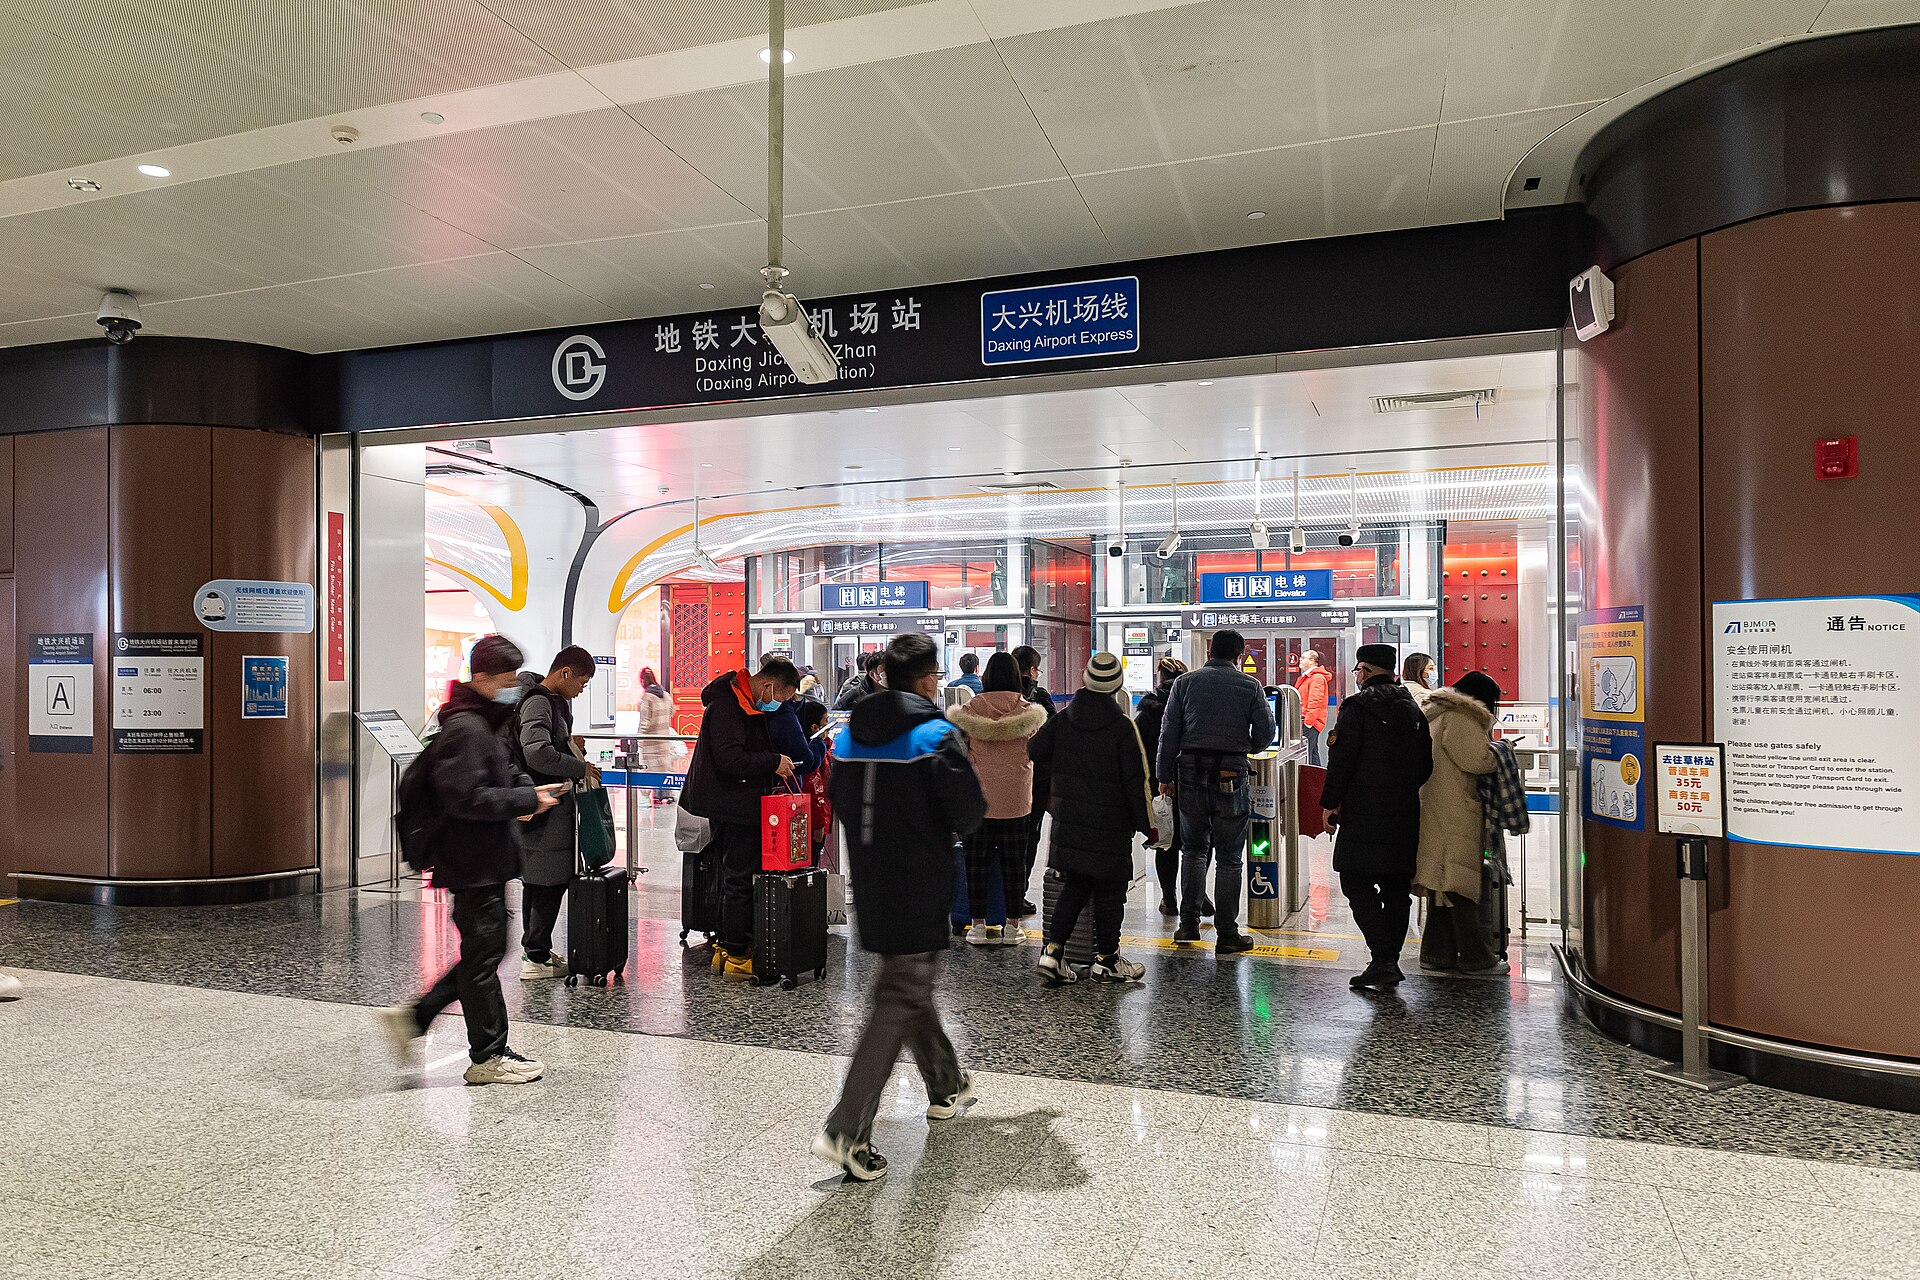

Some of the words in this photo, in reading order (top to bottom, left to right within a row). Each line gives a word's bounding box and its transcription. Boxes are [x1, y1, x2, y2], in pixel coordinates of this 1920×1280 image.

[992, 292, 1128, 332] 大兴机场线
[655, 297, 921, 353] 地铁大机场站
[988, 339, 1031, 352] Daxing
[1034, 333, 1077, 349] Airport
[1080, 328, 1134, 344] Express
[695, 355, 752, 373] Daxing
[696, 376, 752, 393] (Daxing
[1274, 575, 1307, 588] 电梯
[880, 586, 906, 598] 电梯
[1274, 590, 1307, 598] Elevator
[1826, 616, 1866, 632] 通告
[37, 636, 85, 645] 地铁大兴机场站
[1727, 644, 1792, 655] 安全使用闸机
[52, 682, 70, 710] A
[1727, 740, 1752, 748] Please
[1795, 743, 1821, 751] safely
[1662, 755, 1715, 766] 去往草桥站
[1668, 766, 1710, 777] 普通车厢
[1676, 778, 1702, 788] 35元
[1669, 790, 1710, 801] 商务车厢
[1677, 802, 1702, 812] 50元
